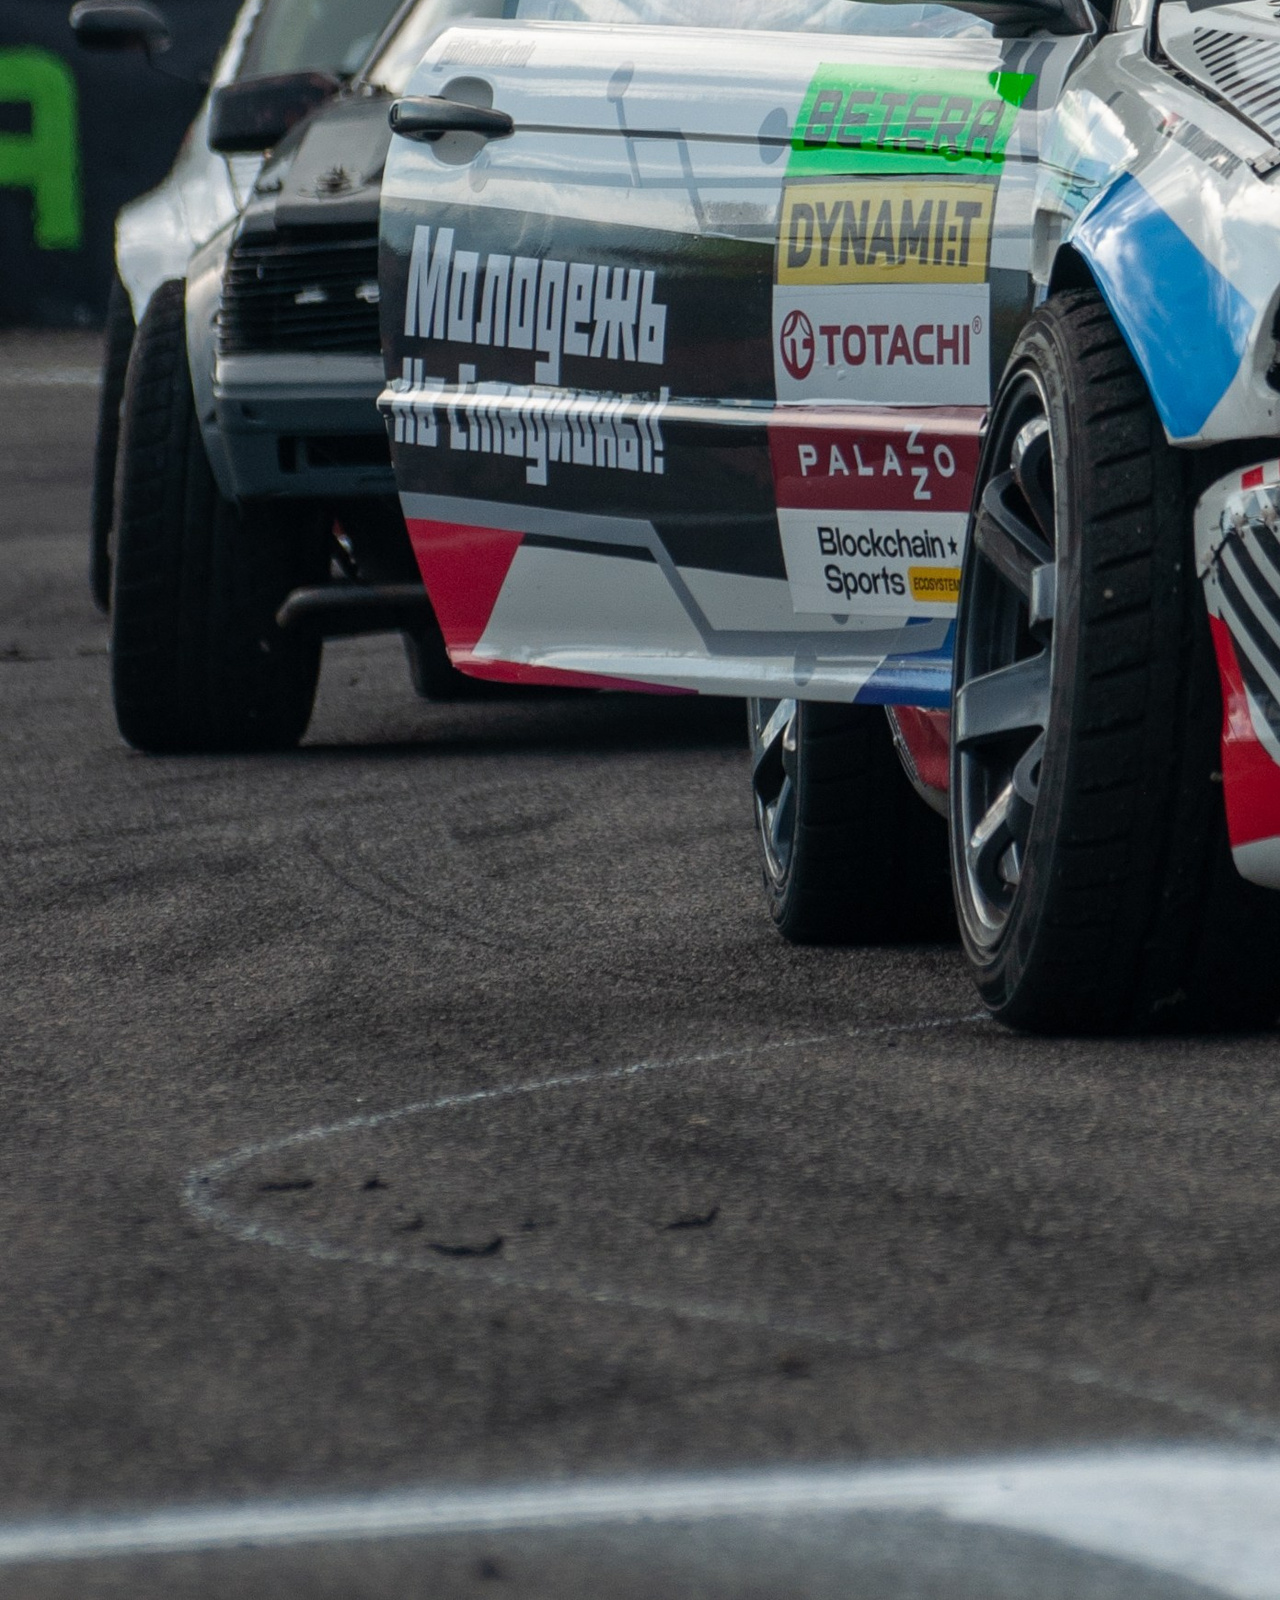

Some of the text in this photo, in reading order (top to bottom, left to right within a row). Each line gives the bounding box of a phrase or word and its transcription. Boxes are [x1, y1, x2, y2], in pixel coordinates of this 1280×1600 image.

[404, 225, 668, 385] Молодежь
[817, 526, 946, 558] Blockchain
[824, 564, 906, 600] Sports
